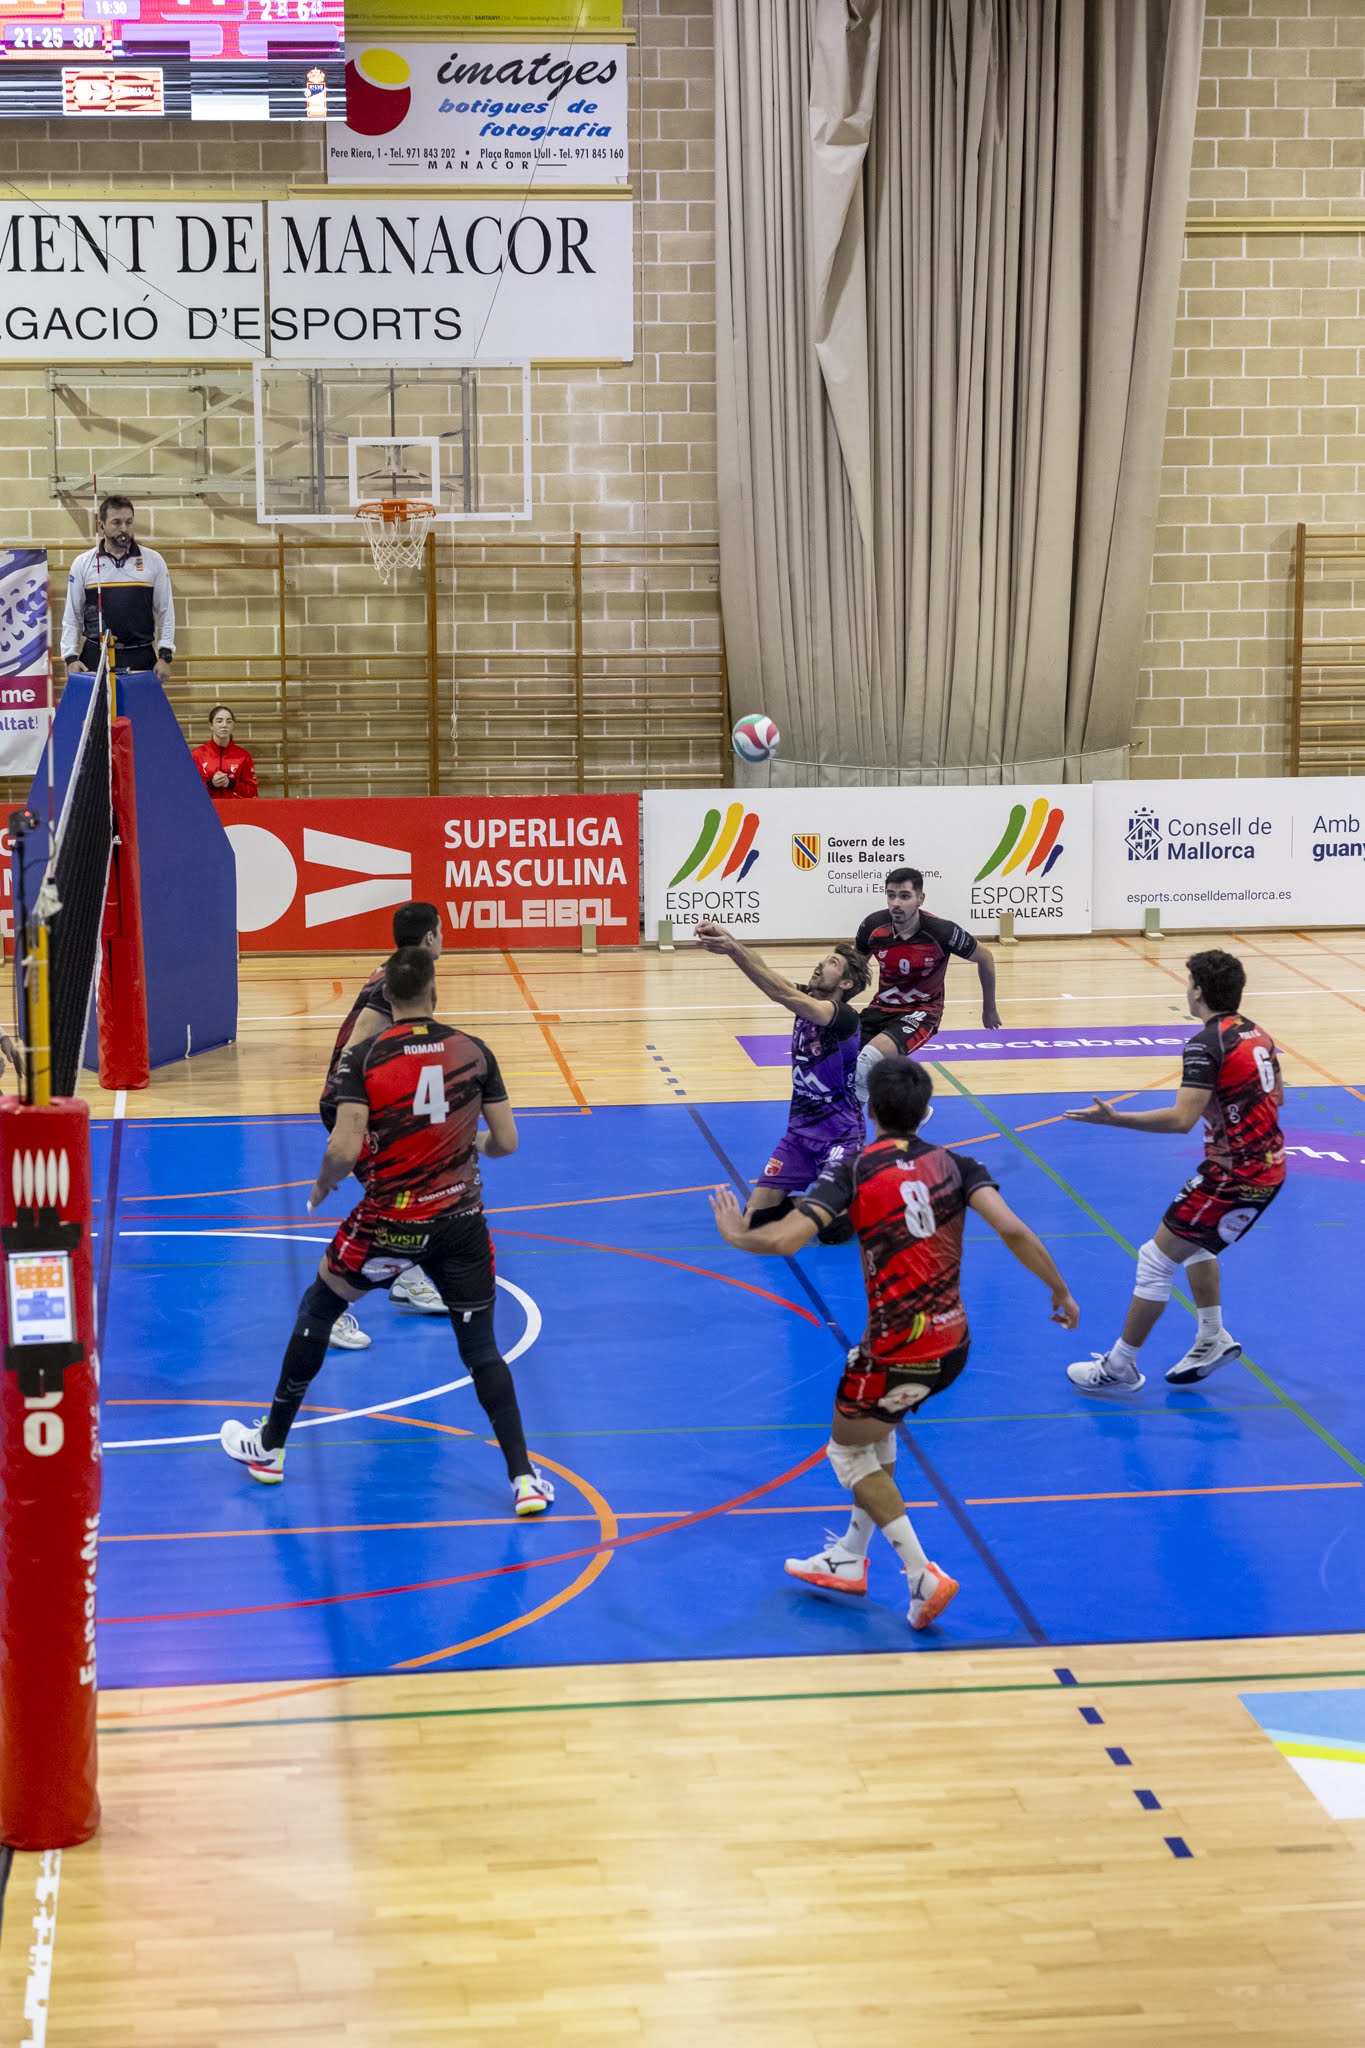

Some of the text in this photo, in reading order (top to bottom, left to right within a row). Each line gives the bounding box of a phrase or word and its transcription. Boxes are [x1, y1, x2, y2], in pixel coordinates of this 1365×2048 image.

[437, 53, 617, 101] imatges
[438, 98, 599, 117] botigues de
[479, 122, 612, 141] fotografia
[331, 148, 348, 158] Pere
[351, 147, 375, 160] Riera,
[377, 148, 381, 158] 1
[390, 148, 404, 158] Tel.
[406, 148, 420, 158] 971
[423, 148, 438, 158] 843
[441, 148, 456, 158] 202
[480, 148, 502, 160] Plaça
[504, 148, 532, 159] Ramon
[534, 148, 551, 159] Llull
[559, 148, 573, 159] Tel.
[575, 148, 589, 159] 971
[592, 148, 607, 159] 845
[610, 148, 624, 159] 160
[428, 161, 529, 169] MANACOR
[176, 215, 258, 275] DE
[282, 216, 597, 276] MANACOR
[0, 294, 158, 340] GACIÓ
[0, 688, 36, 703] me
[1168, 817, 1272, 837] Consell de
[1312, 813, 1360, 833] Amb
[444, 817, 622, 849] SUPERLIGA
[827, 836, 905, 847] Govern de les
[827, 851, 905, 863] Illes Balears
[1167, 842, 1255, 860] Mallorca
[1312, 842, 1365, 862] guan
[445, 858, 627, 888] MASCULINA
[827, 869, 882, 879] Conselleria
[827, 884, 863, 894] Cultura
[866, 884, 869, 893] i
[971, 885, 1063, 905] ESPORTS
[1127, 890, 1292, 904] esports.conselldemallorca.es
[666, 891, 760, 910] ESPORTS
[446, 899, 627, 929] VOLEIBOL
[665, 912, 760, 924] ILLES BALEARS
[970, 907, 1063, 919] ILLES BALEARS
[899, 959, 910, 975] 9
[403, 1042, 445, 1054] ROMANI
[919, 1037, 1191, 1051] onectabale
[1253, 1046, 1275, 1093] 6
[413, 1064, 450, 1125] 4
[900, 1180, 936, 1238] 8
